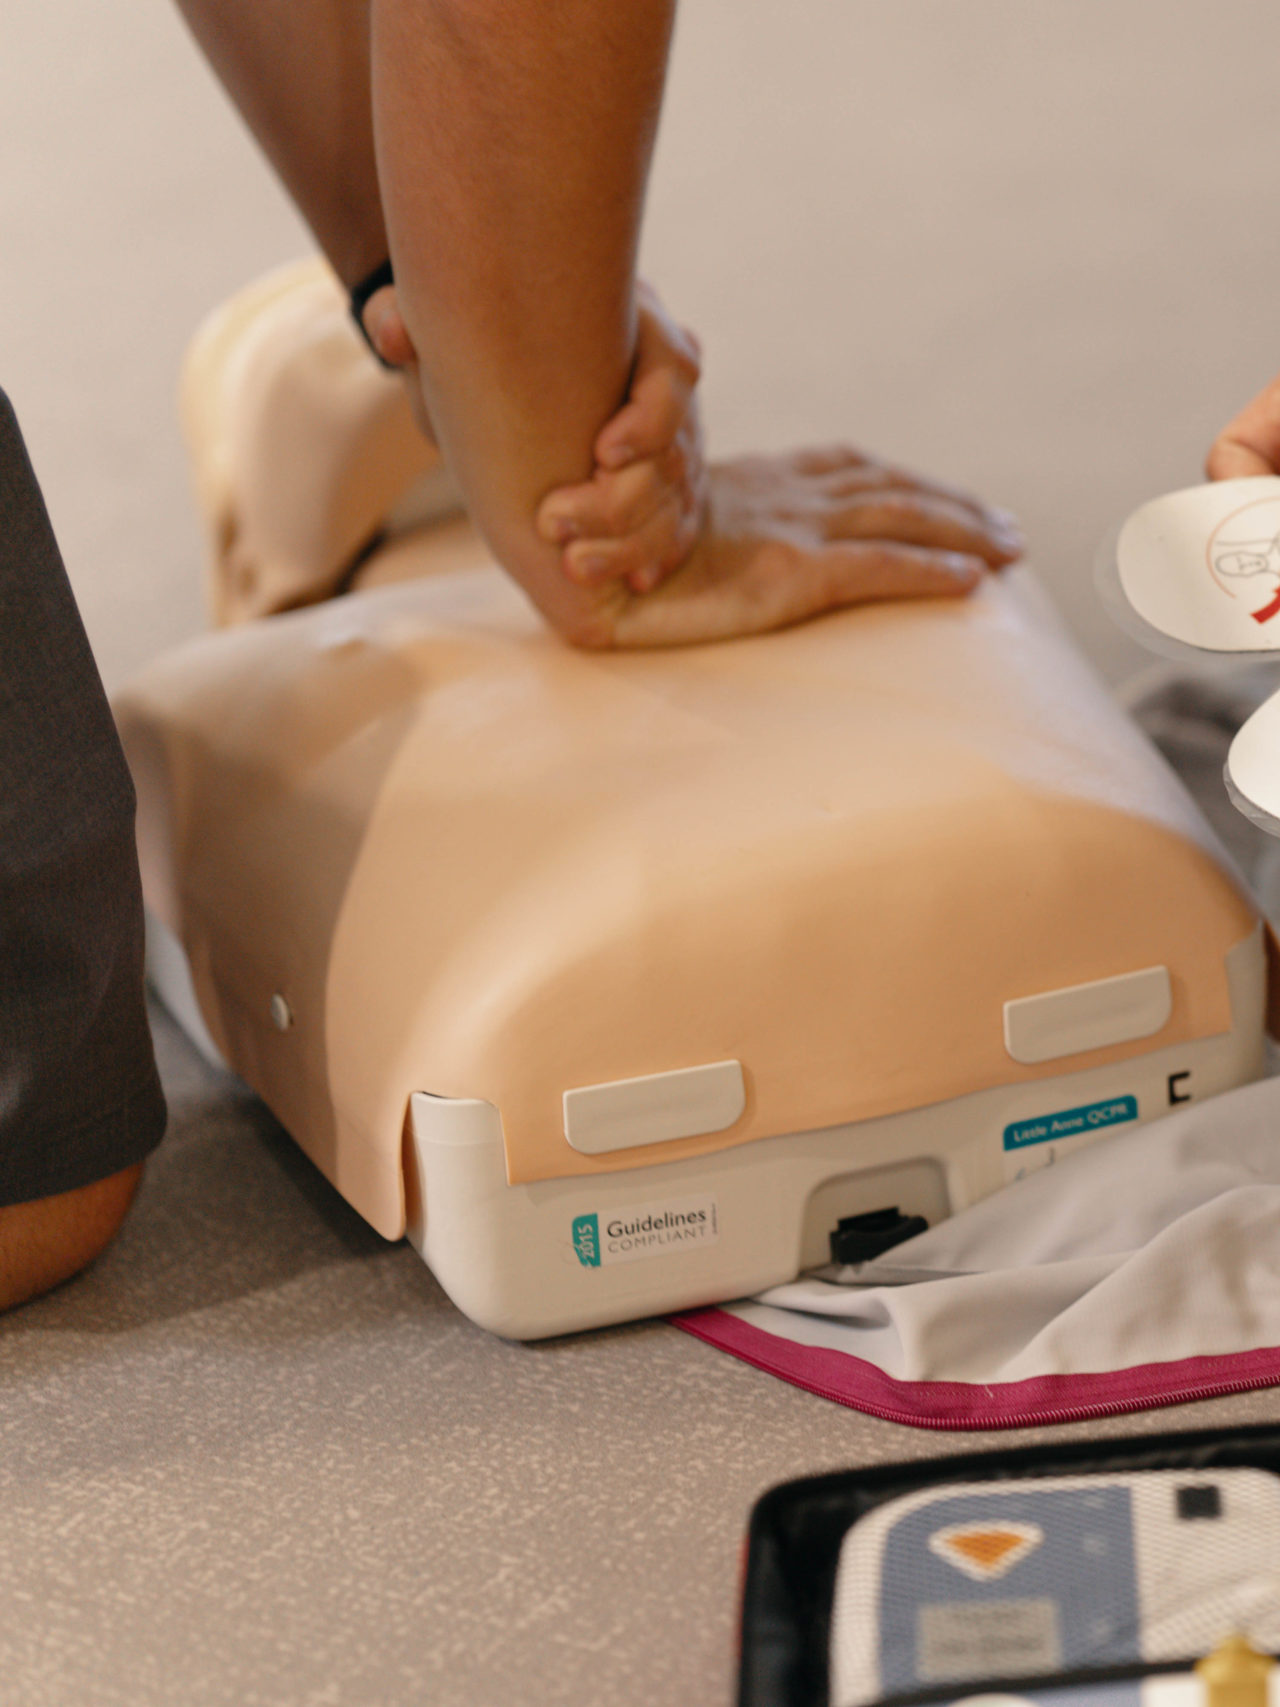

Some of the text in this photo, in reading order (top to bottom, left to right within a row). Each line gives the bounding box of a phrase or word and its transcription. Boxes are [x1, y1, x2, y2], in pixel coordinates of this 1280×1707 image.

[607, 1209, 706, 1239] Guidelines
[607, 1225, 706, 1253] COMPLIANT
[577, 1224, 596, 1259] 2015
